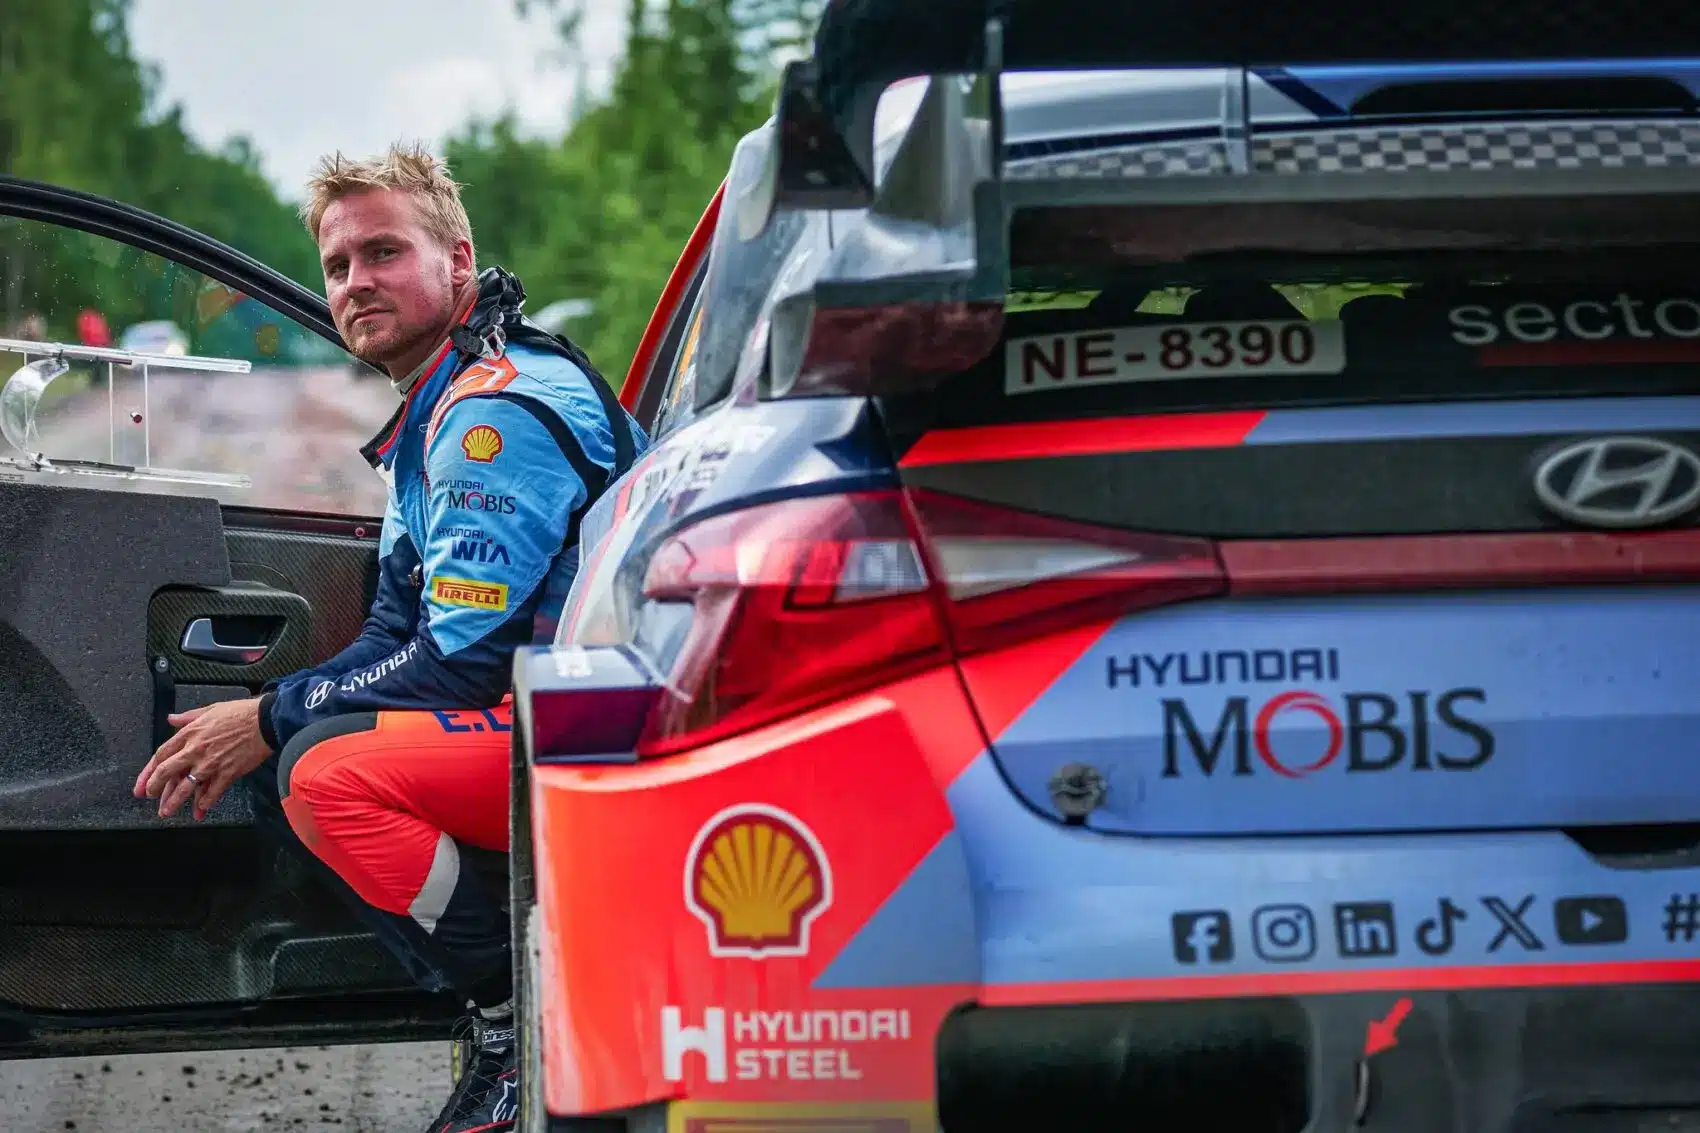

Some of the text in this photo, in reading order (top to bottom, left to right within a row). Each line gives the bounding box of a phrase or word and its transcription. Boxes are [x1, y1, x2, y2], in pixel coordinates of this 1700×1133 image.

[1449, 293, 1700, 345] secto
[1021, 321, 1317, 385] NE-8390
[438, 480, 484, 491] HYUNDAI
[448, 490, 516, 515] MOBIS
[437, 527, 484, 539] HYUNDAI
[451, 539, 511, 565] WIA
[437, 582, 501, 605] PIRELLI
[1107, 648, 1340, 688] HYUNDAI
[1161, 689, 1496, 778] MOBIS
[733, 1009, 909, 1043] HYUNDAI
[736, 1049, 863, 1081] STEEL
